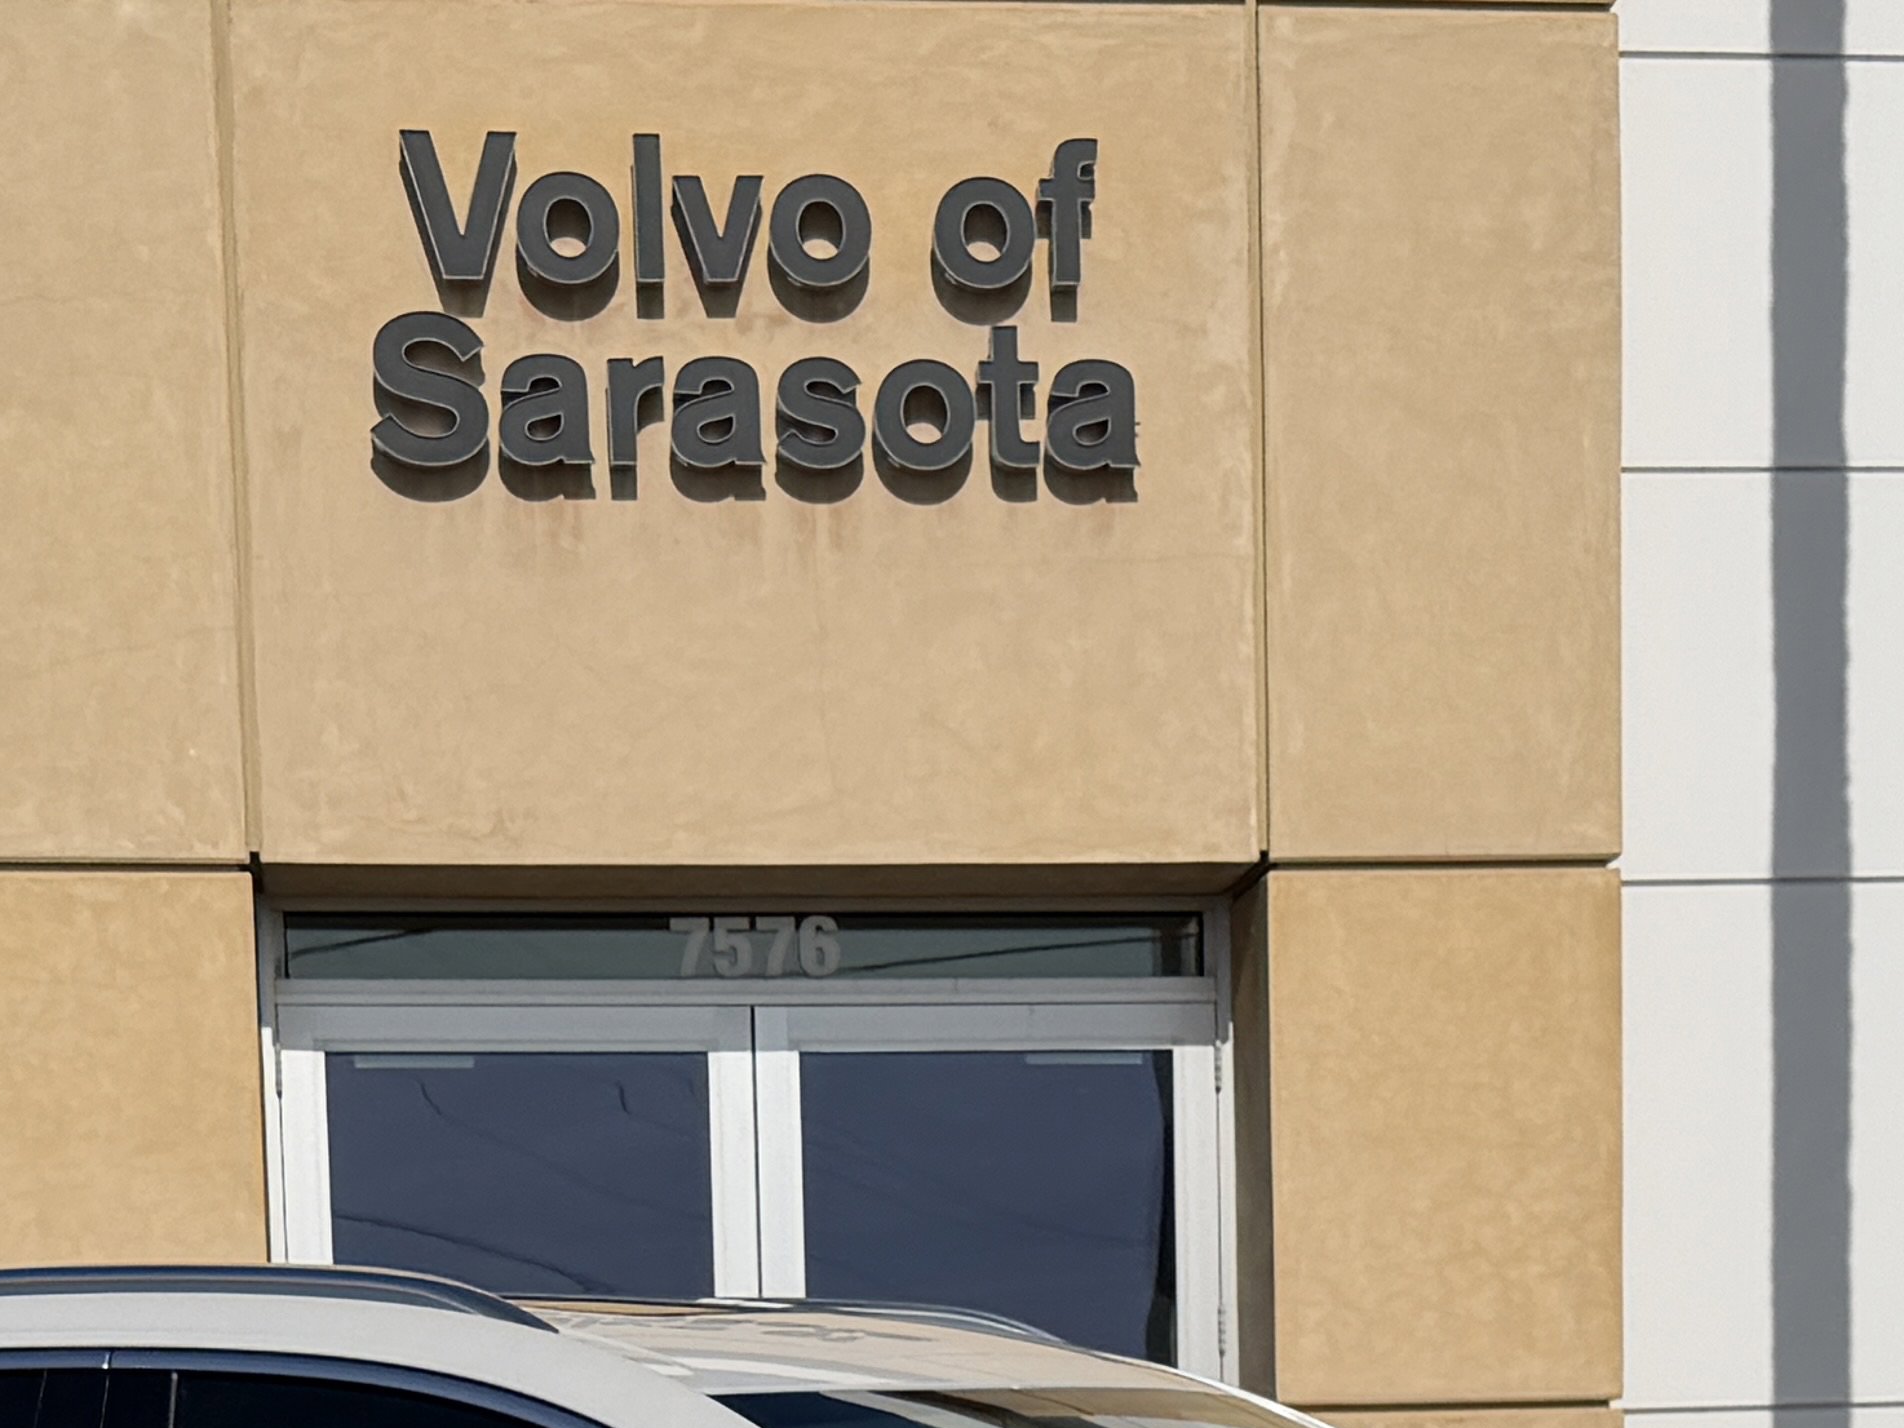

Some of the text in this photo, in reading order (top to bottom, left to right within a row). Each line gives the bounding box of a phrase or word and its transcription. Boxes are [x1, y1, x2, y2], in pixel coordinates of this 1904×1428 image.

[399, 130, 1099, 290] Volvo of
[370, 310, 1141, 472] Sarasota
[669, 914, 842, 978] 7576
